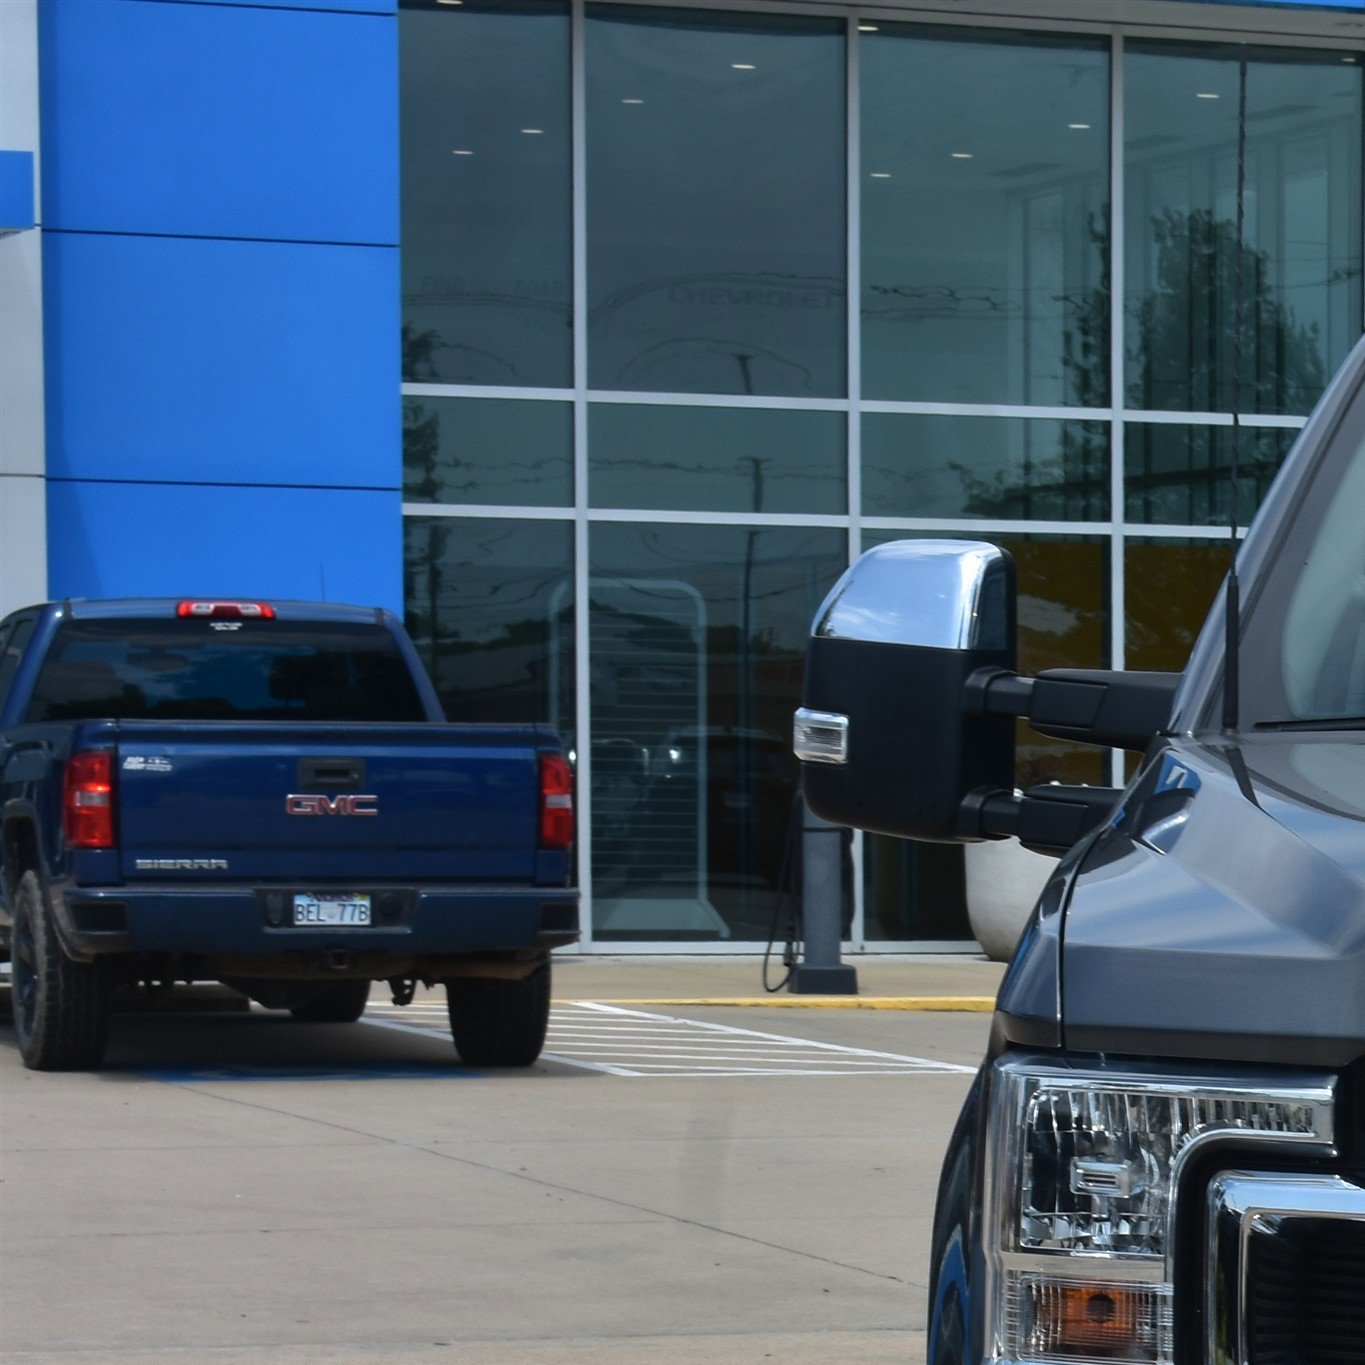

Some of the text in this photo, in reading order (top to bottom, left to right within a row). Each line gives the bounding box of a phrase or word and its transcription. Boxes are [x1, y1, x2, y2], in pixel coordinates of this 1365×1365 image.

[286, 794, 378, 815] GMC
[136, 859, 228, 869] SIERRA
[295, 903, 326, 922] BEL
